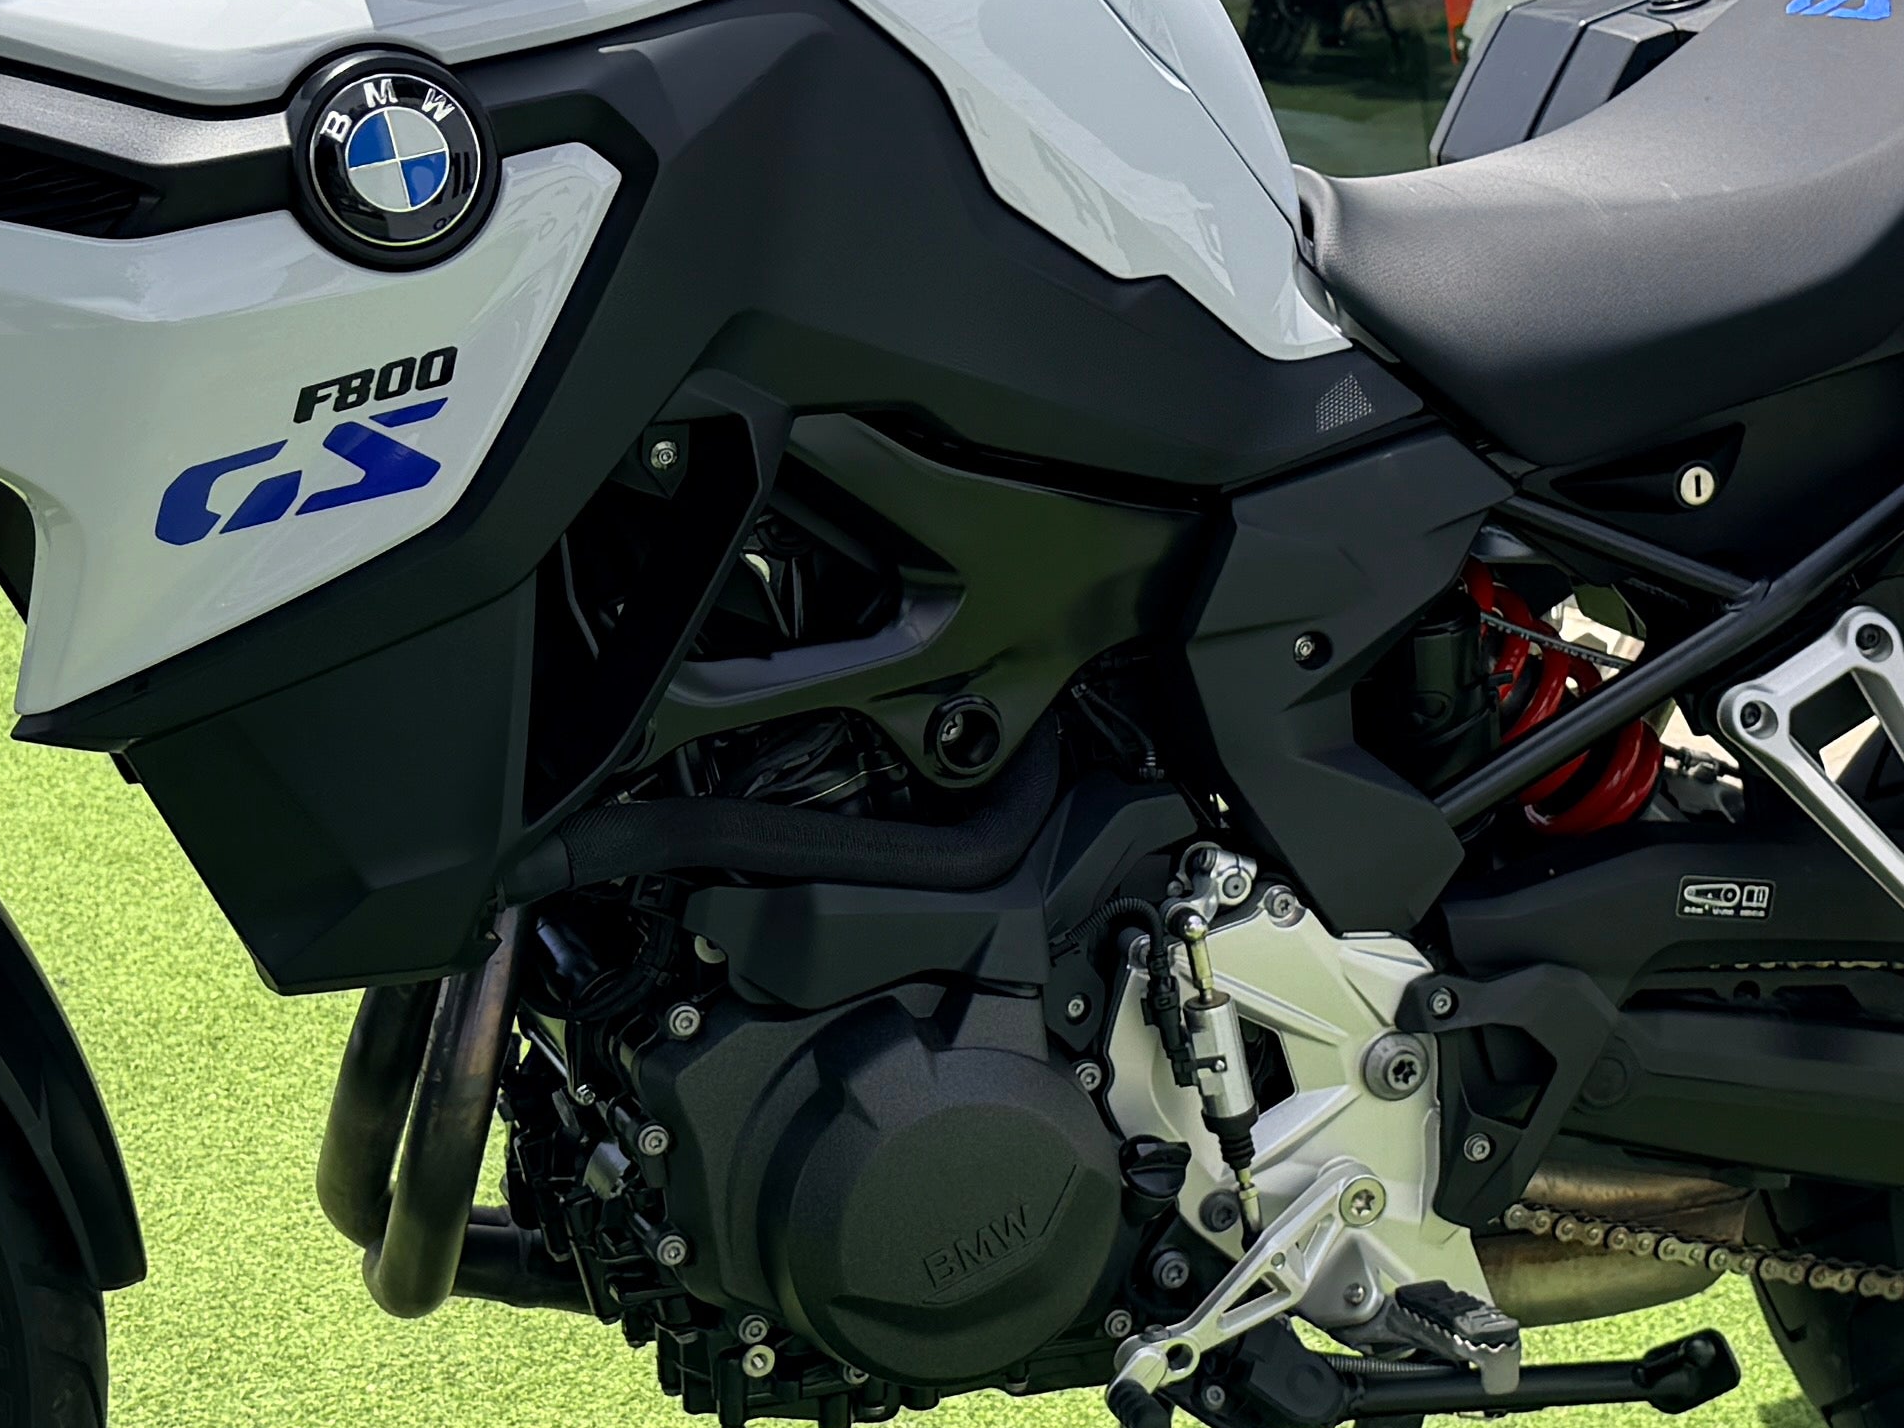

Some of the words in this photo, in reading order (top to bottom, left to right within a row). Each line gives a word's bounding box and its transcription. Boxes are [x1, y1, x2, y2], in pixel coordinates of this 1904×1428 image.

[319, 78, 456, 143] BMW
[293, 345, 458, 424] F800
[154, 397, 449, 547] GS
[923, 1202, 1032, 1290] BMW
